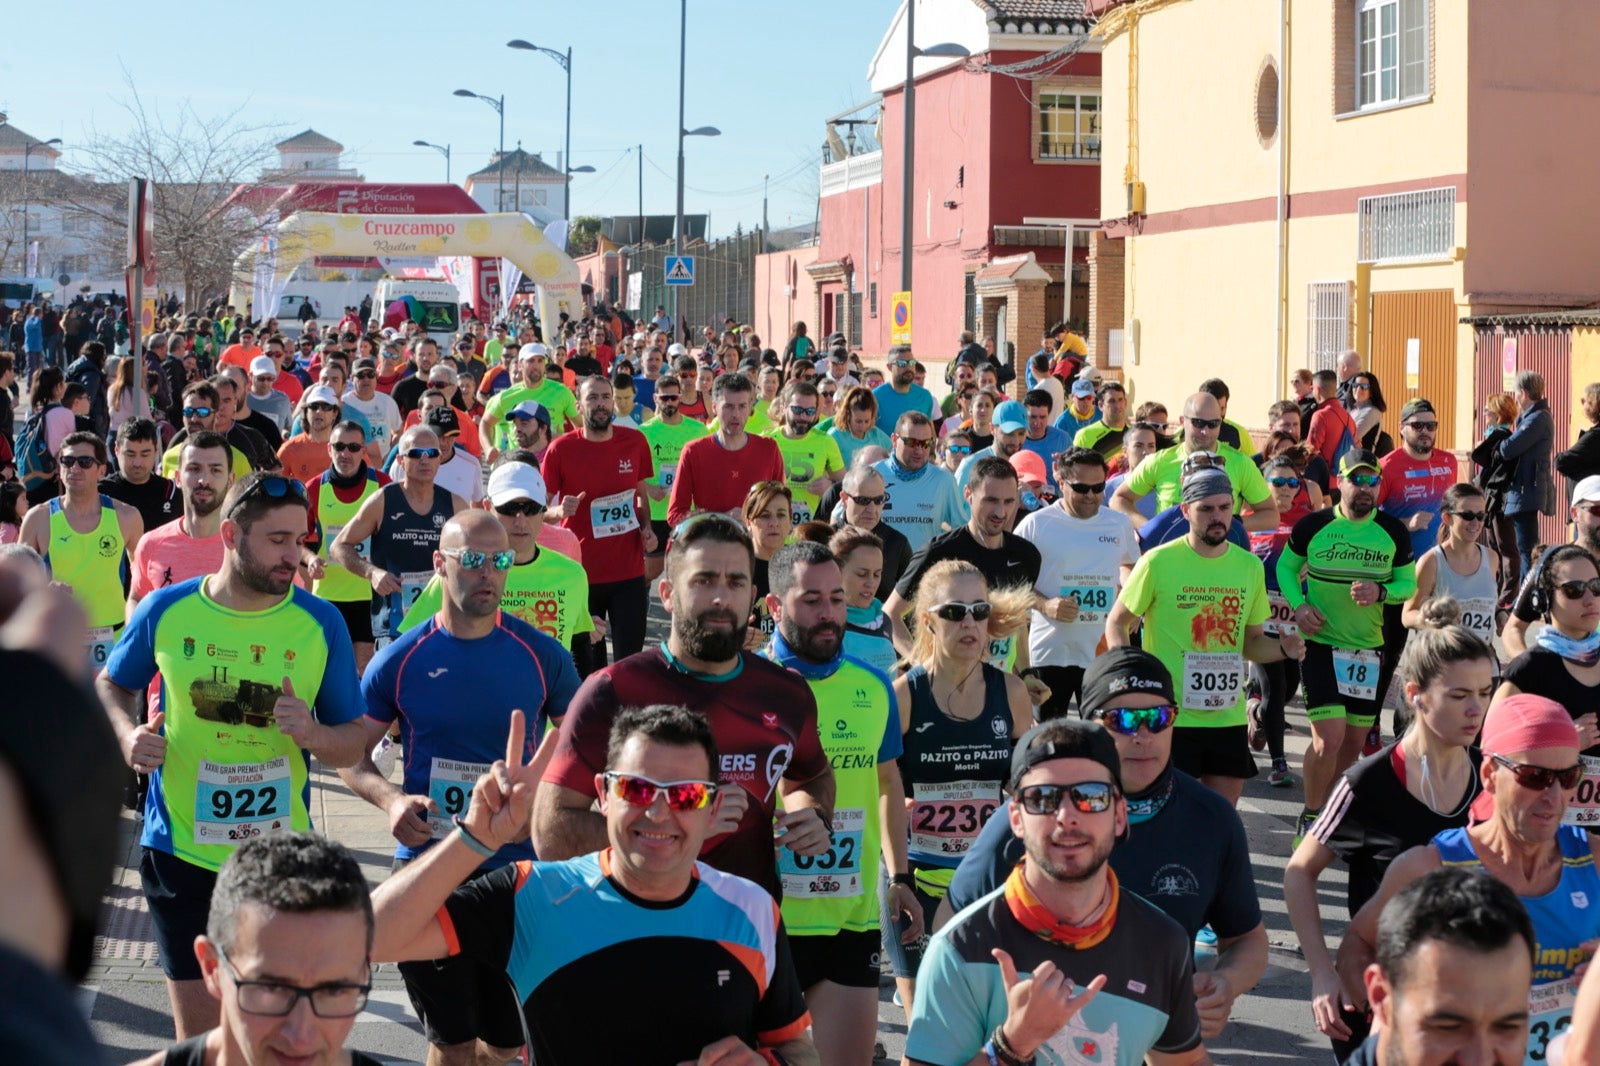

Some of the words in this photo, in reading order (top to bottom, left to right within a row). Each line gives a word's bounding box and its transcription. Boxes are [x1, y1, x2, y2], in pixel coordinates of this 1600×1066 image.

[362, 190, 415, 202] Diputación
[362, 204, 373, 213] de
[374, 203, 415, 213] Granada
[365, 220, 455, 236] Cruzcampo
[599, 503, 631, 523] 798
[392, 532, 418, 540] PAZITO
[1326, 549, 1390, 562] granabike
[517, 590, 556, 598] PREMIO
[1208, 586, 1239, 595] PREMIO
[499, 599, 526, 607] ONDO
[1189, 594, 1216, 602] FONDO
[1347, 663, 1367, 683] 18
[1190, 672, 1239, 691] 3035
[719, 753, 757, 771] ERS
[920, 752, 961, 762] PAZITO
[973, 749, 1009, 760] PAZITO
[219, 766, 236, 774] GRAN
[237, 764, 258, 774] PREMIO
[266, 758, 285, 769] FONDO
[454, 762, 470, 772] GRAN
[954, 762, 980, 771] Motril
[227, 774, 263, 784] DIPUTACIÓN
[211, 786, 277, 818] 922
[445, 786, 473, 815] 9
[1533, 942, 1584, 970] imp
